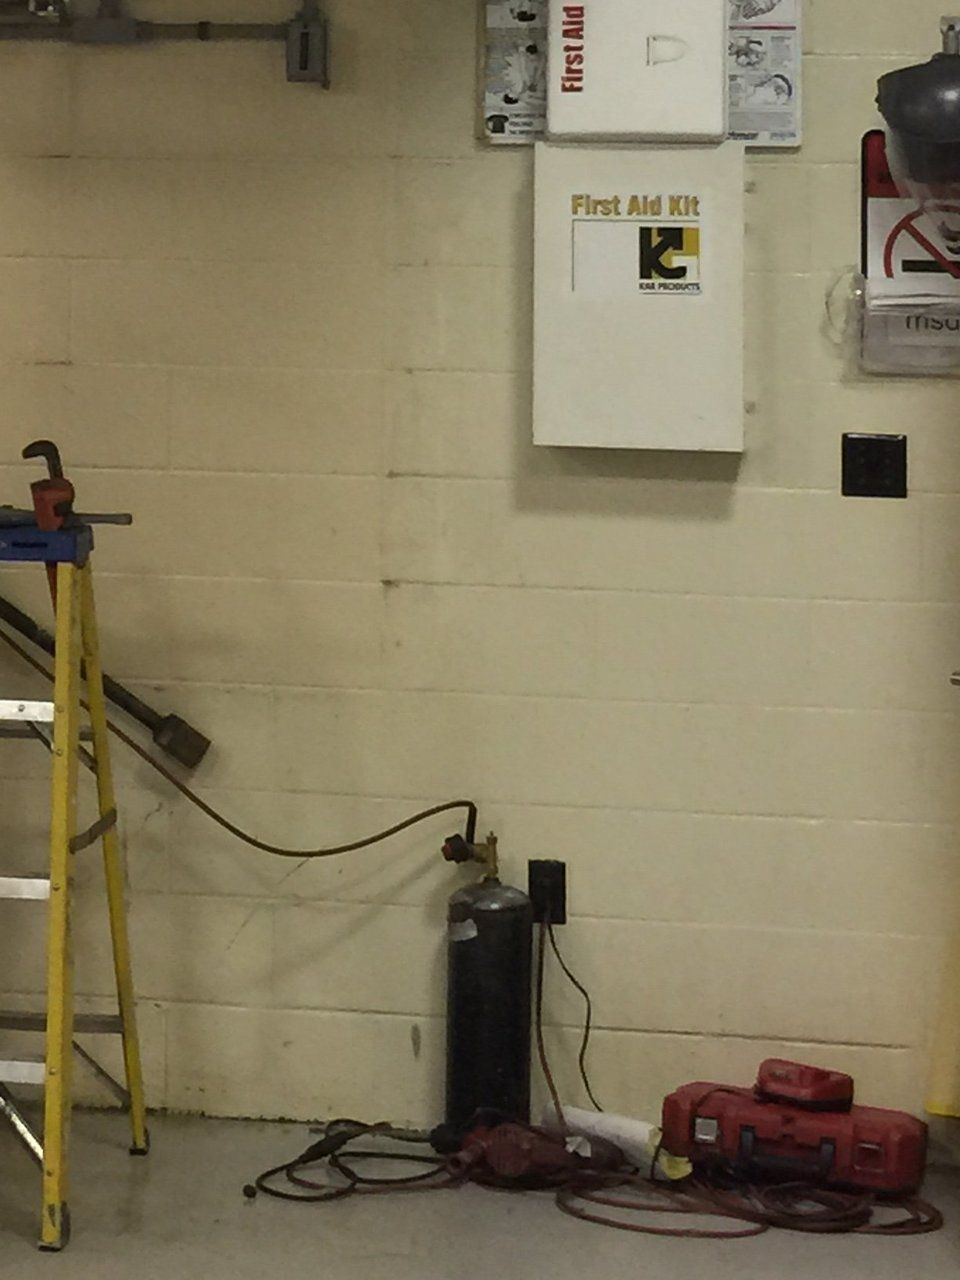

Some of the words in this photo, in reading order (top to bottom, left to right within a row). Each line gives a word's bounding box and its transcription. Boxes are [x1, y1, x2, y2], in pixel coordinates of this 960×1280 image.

[562, 6, 584, 39] Aid
[561, 45, 584, 93] First
[572, 195, 621, 216] First
[627, 195, 662, 216] Aid
[668, 195, 700, 216] Kit
